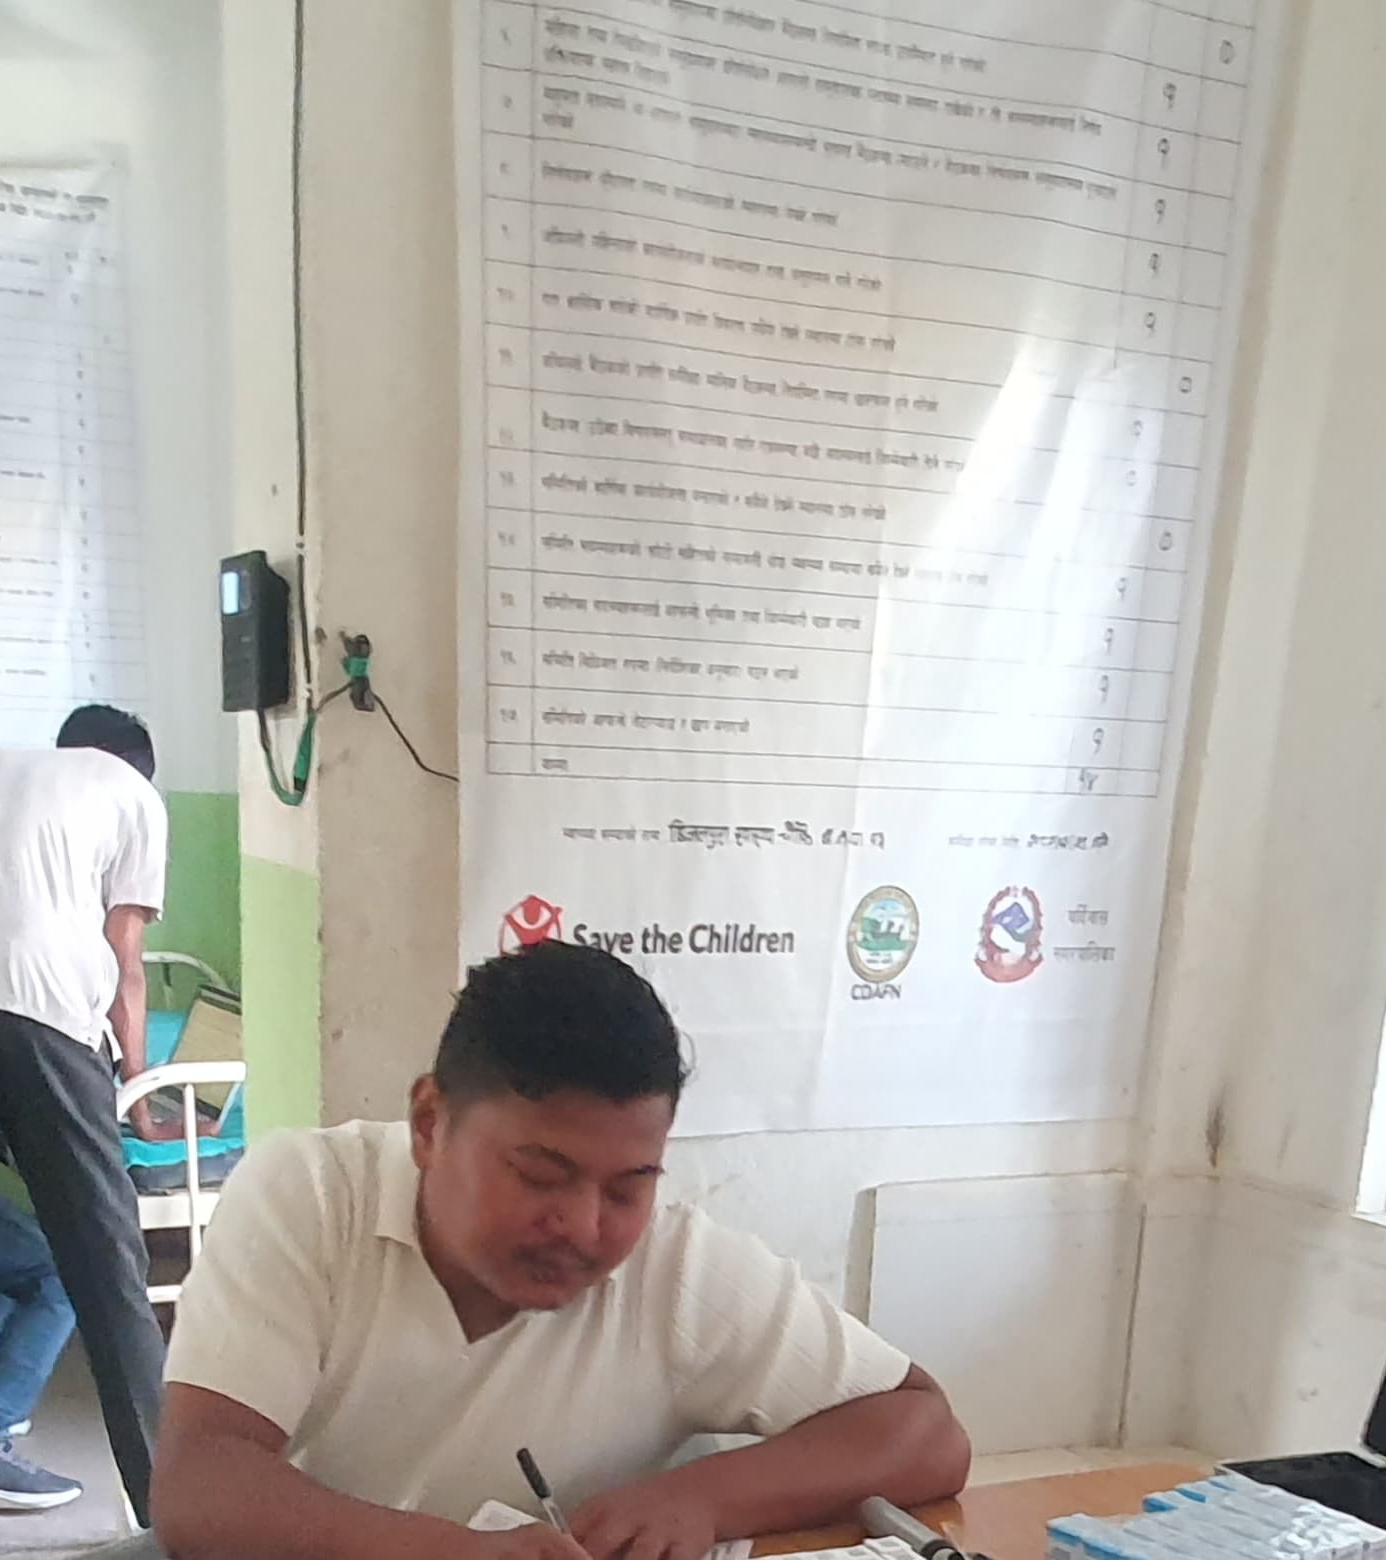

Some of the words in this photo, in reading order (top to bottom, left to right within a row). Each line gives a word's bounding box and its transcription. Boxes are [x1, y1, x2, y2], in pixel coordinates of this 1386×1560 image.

[573, 923, 635, 956] Save
[641, 921, 683, 954] the
[688, 922, 795, 956] Children
